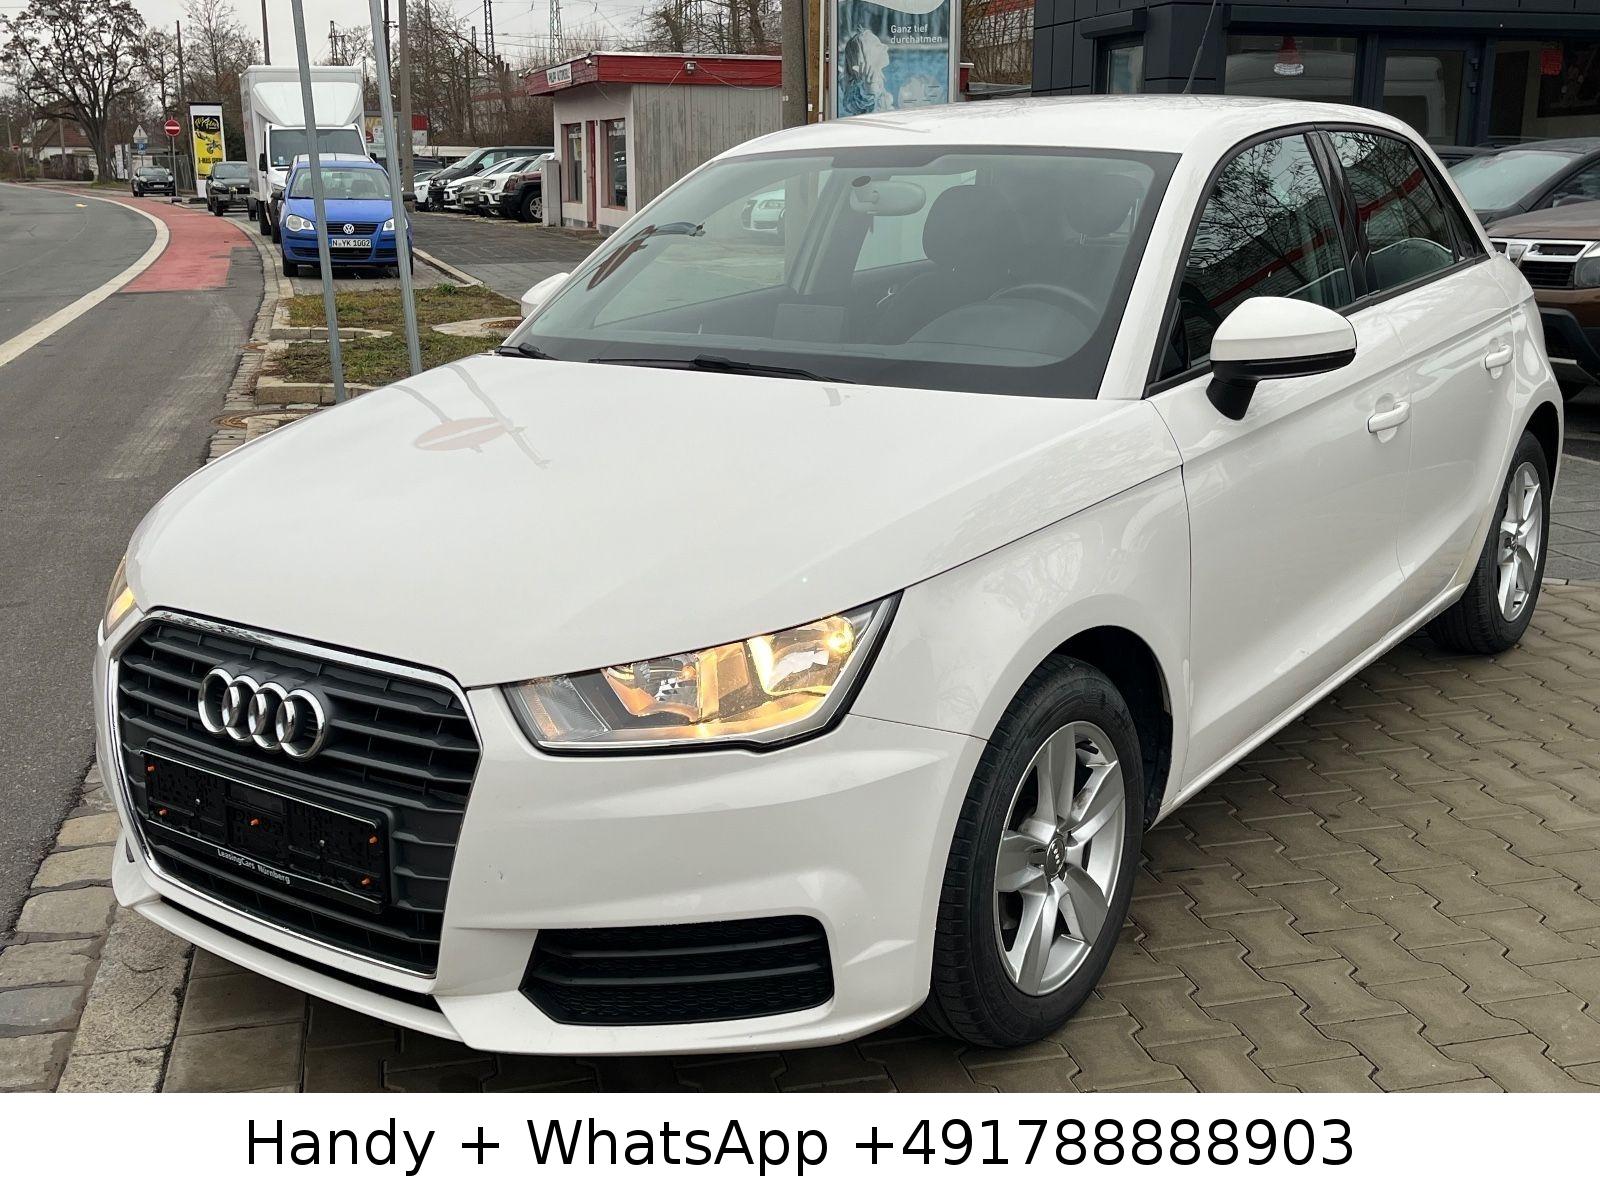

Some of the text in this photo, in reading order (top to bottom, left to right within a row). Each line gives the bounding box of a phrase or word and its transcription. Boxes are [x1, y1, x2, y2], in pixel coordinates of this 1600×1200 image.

[890, 24, 928, 33] Ganz tief
[890, 35, 943, 43] durchatmen
[217, 848, 255, 869] LeasingCars
